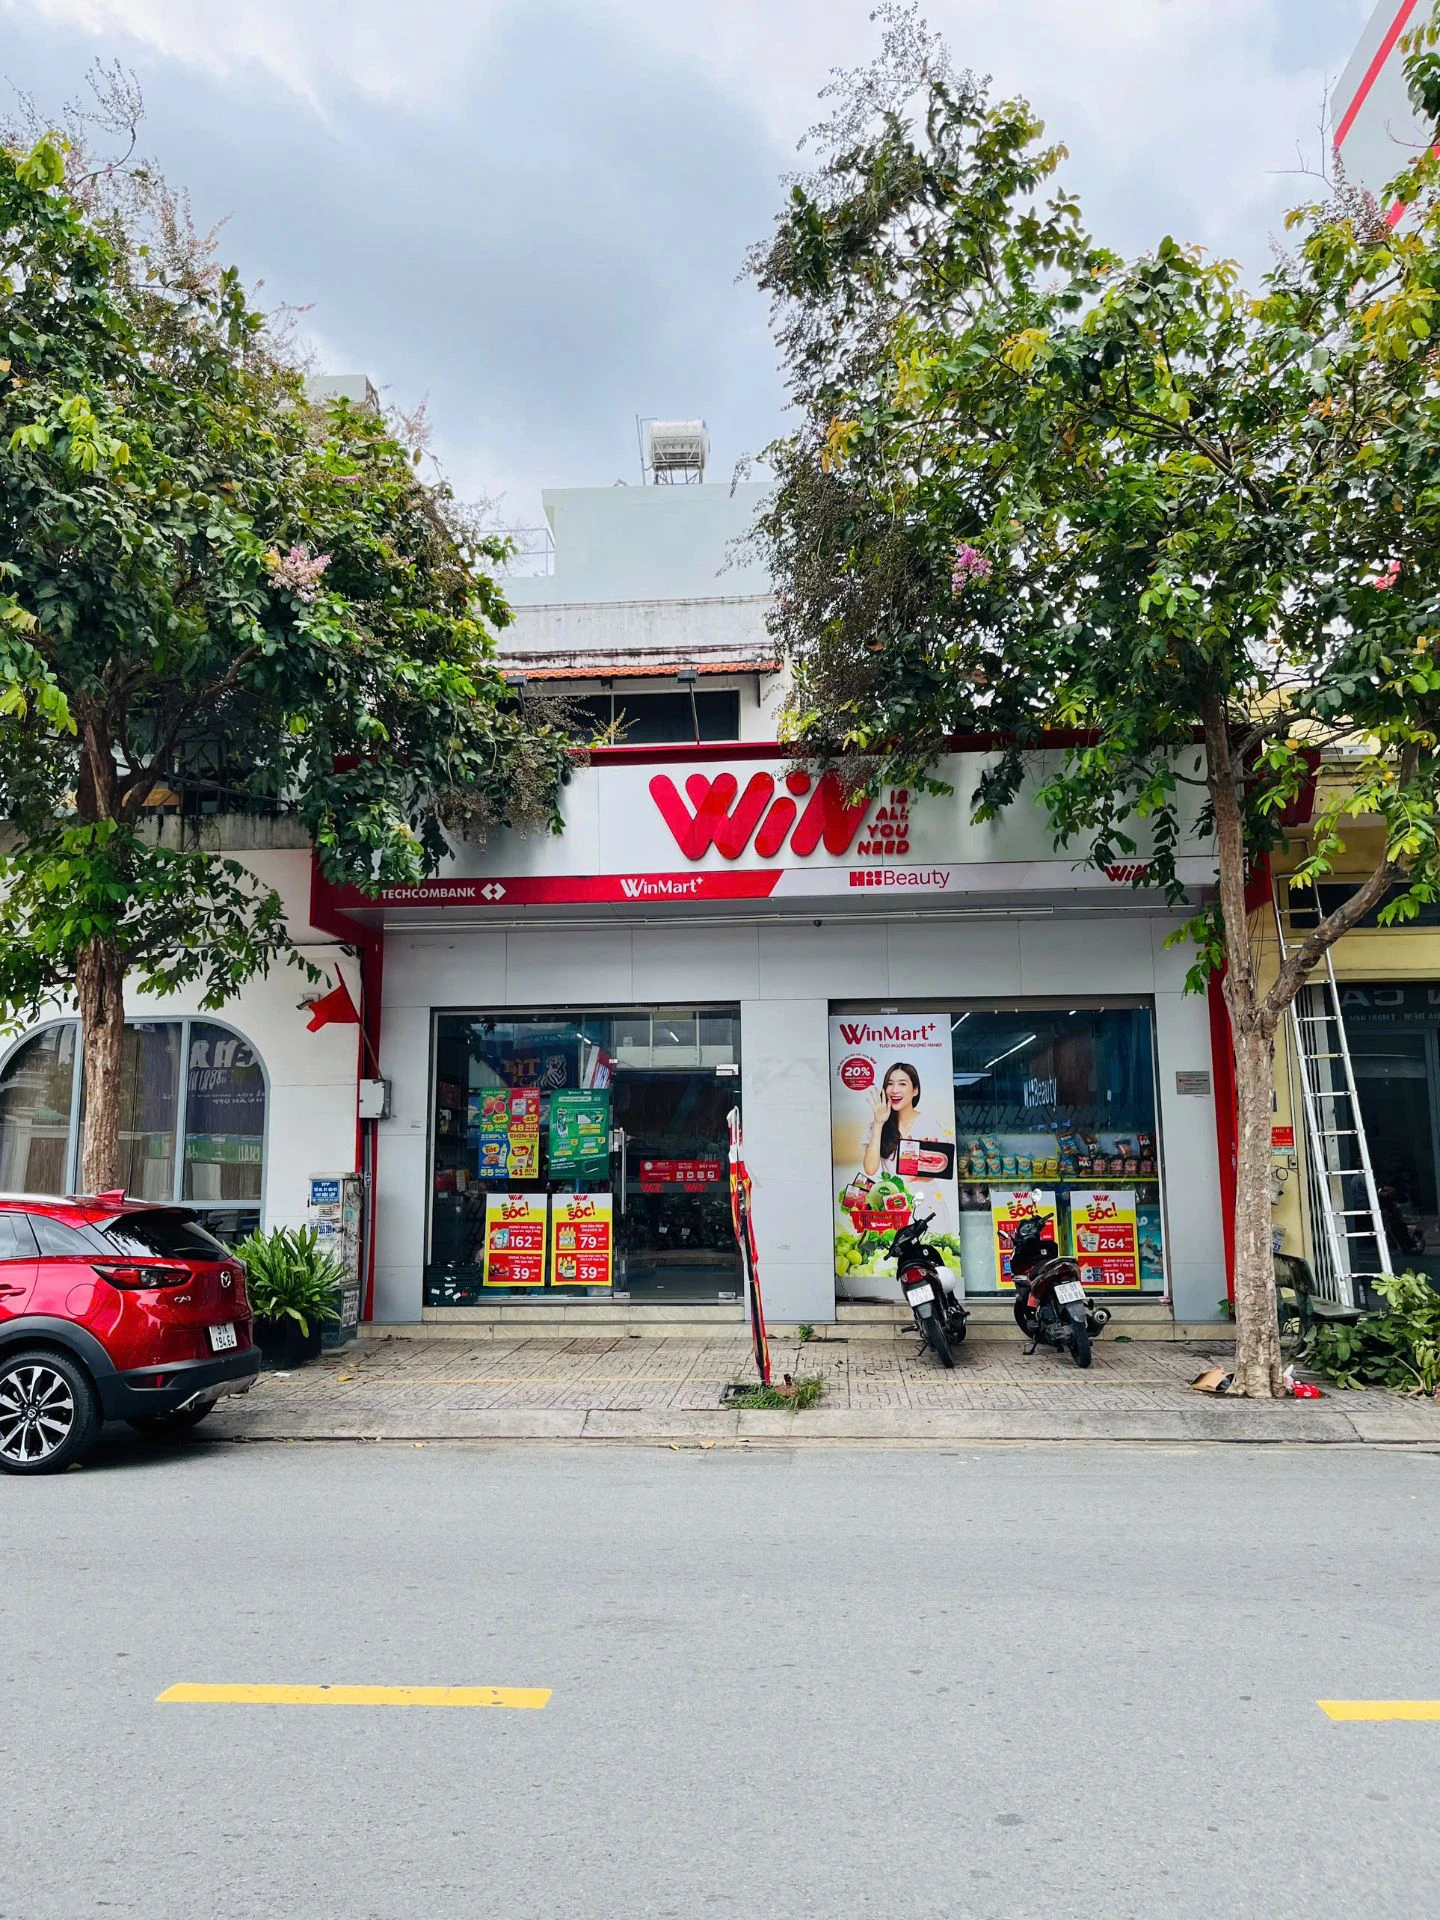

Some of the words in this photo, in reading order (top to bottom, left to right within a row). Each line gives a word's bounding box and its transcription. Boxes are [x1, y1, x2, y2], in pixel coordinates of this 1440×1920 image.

[867, 824, 909, 838] YOU
[857, 840, 910, 855] NEED
[381, 886, 476, 900] TECHCOMBANK
[845, 1066, 871, 1077] 20%
[511, 1124, 524, 1132] 48
[480, 1168, 494, 1177] 55
[511, 1168, 523, 1176] 41
[510, 1236, 532, 1248] 162
[580, 1236, 597, 1248] 79
[1100, 1238, 1125, 1249] 264
[513, 1267, 530, 1280] 39
[580, 1266, 597, 1279] 39
[1104, 1272, 1125, 1284] 119
